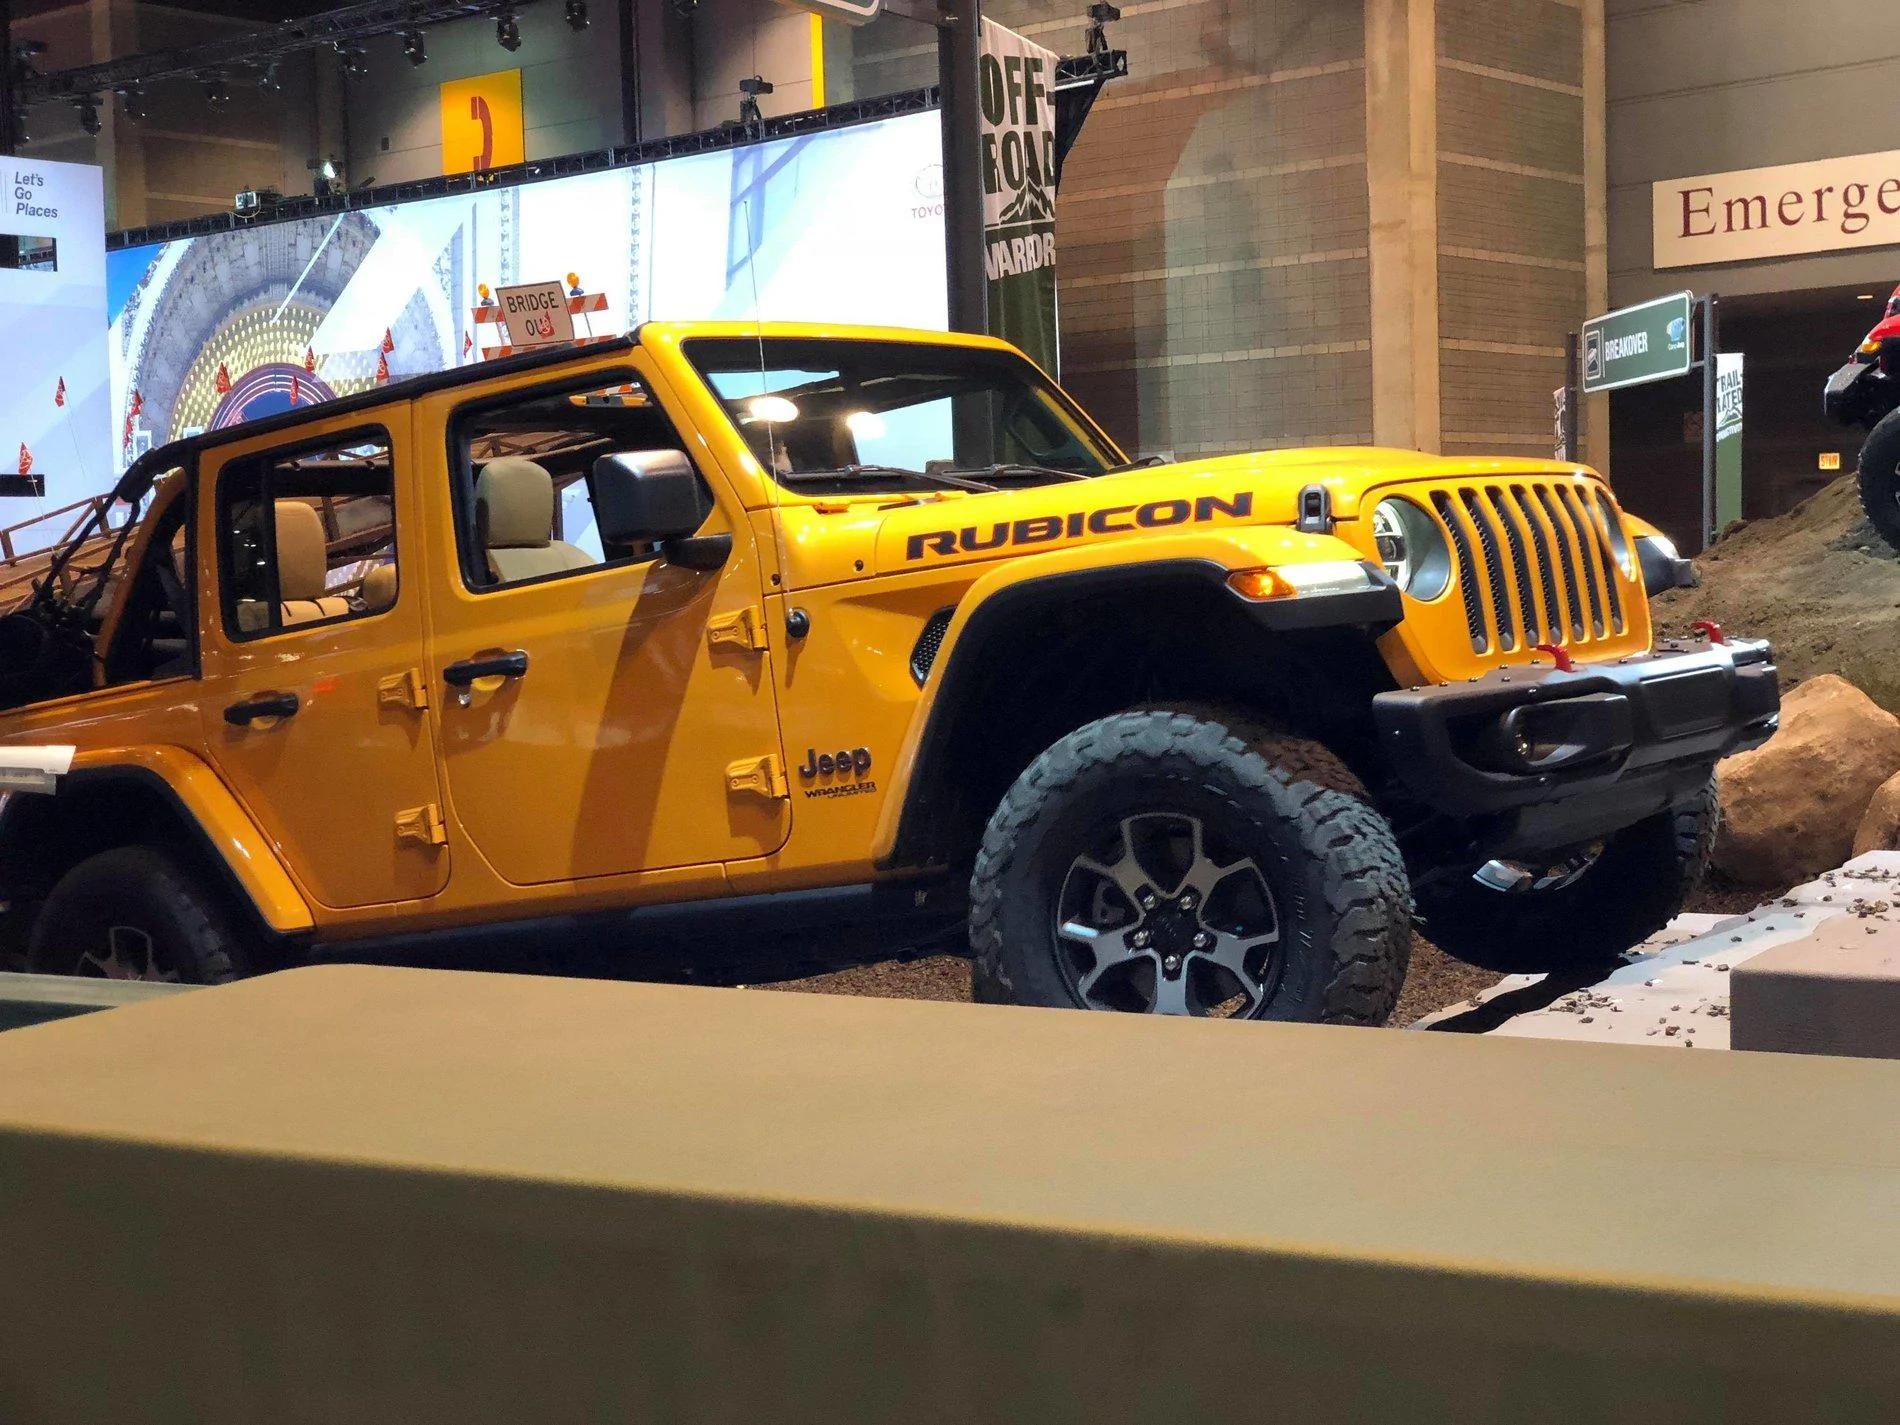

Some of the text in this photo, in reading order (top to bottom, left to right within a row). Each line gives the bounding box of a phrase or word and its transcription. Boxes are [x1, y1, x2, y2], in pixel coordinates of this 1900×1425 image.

[979, 53, 1056, 127] OFF-
[982, 130, 1056, 194] ROAD
[15, 171, 44, 186] Let's
[14, 186, 32, 200] Go
[16, 202, 58, 218] Places
[911, 203, 944, 218] TOYO
[1677, 178, 1900, 238] Emerge
[985, 232, 1056, 280] ARROR
[506, 291, 559, 313] BRIDGE
[525, 317, 547, 336] OU
[1605, 331, 1648, 361] BREAKOVER
[906, 491, 1253, 560] RUBICON
[799, 747, 871, 779] Jeep
[804, 781, 876, 798] WRANGLER
